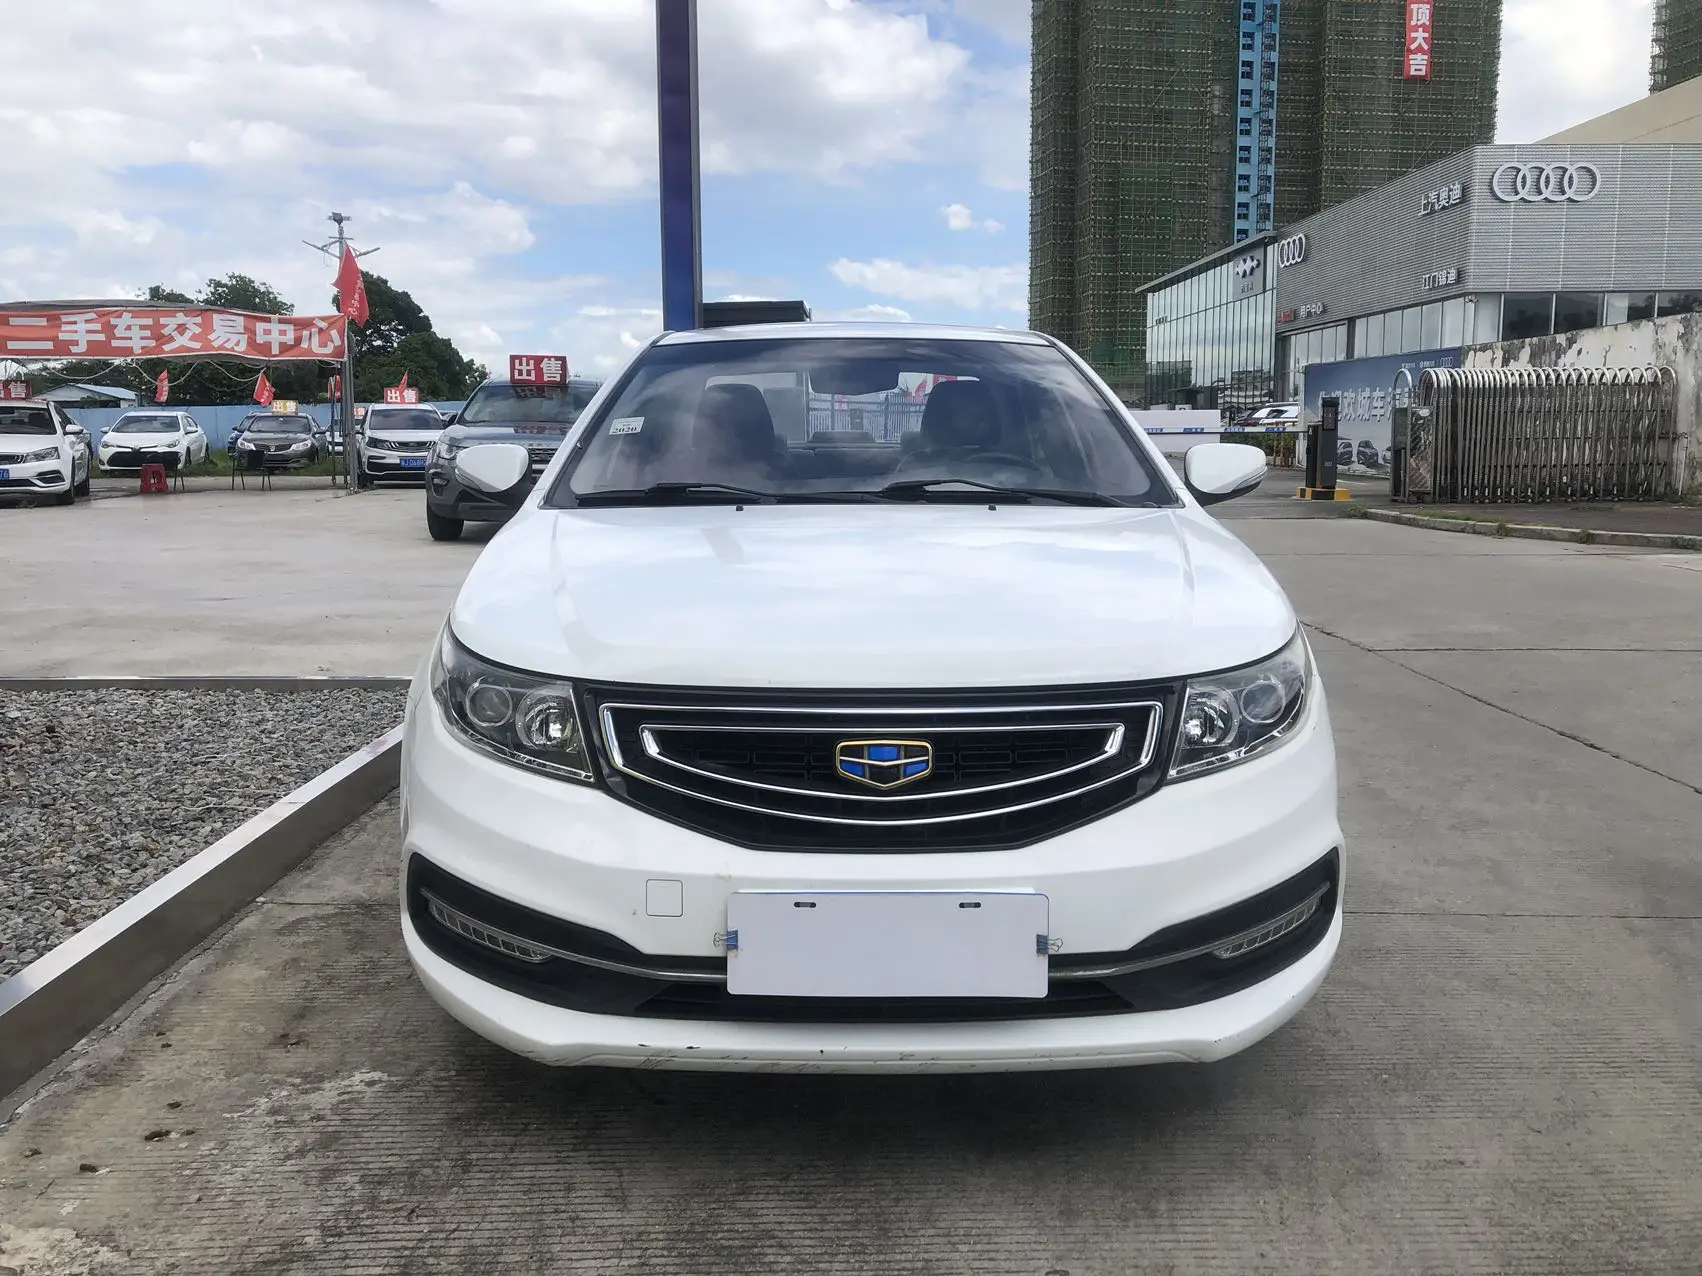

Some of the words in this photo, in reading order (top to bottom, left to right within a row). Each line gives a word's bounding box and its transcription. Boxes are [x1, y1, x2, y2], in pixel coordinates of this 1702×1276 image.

[1409, 3, 1430, 76] 顶大吉
[1418, 181, 1462, 216] 上汽奥迪
[7, 312, 341, 354] 二手车交易中心
[514, 357, 563, 382] 出售
[0, 382, 27, 399] 售
[387, 389, 416, 403] 出售
